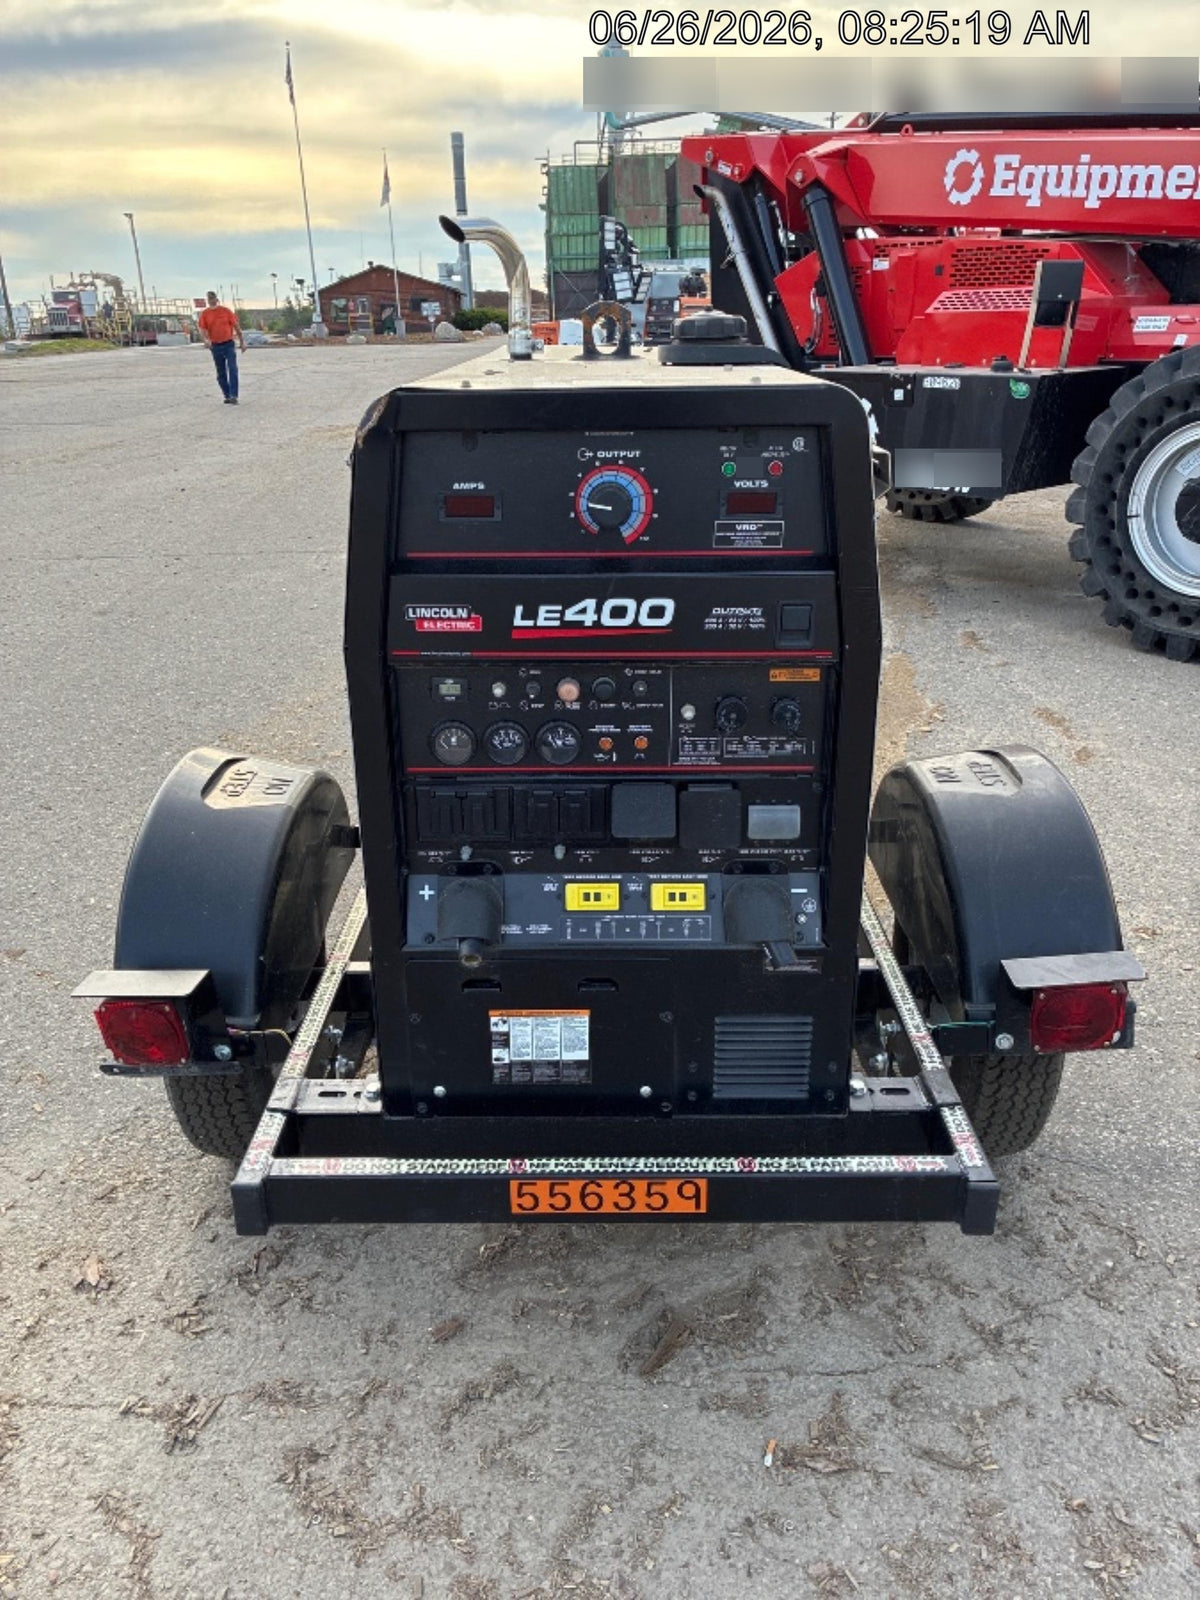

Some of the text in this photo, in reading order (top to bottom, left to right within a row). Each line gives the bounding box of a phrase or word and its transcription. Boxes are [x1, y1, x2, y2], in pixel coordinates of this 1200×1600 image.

[989, 153, 1200, 209] Equipme
[597, 450, 641, 458] OUTPUT
[453, 481, 485, 490] AMPS
[734, 479, 769, 489] VOLTS
[408, 607, 468, 619] LINCOLN
[513, 598, 675, 627] LE400
[424, 620, 476, 630] ELECTRIC
[343, 1162, 366, 1171] DO
[371, 1162, 401, 1171] NOT
[407, 1162, 461, 1171] STAND
[588, 1161, 640, 1169] TENEZ
[644, 1161, 706, 1169] DEBOUT
[760, 1161, 783, 1169] NO
[517, 1180, 701, 1211] 556359
